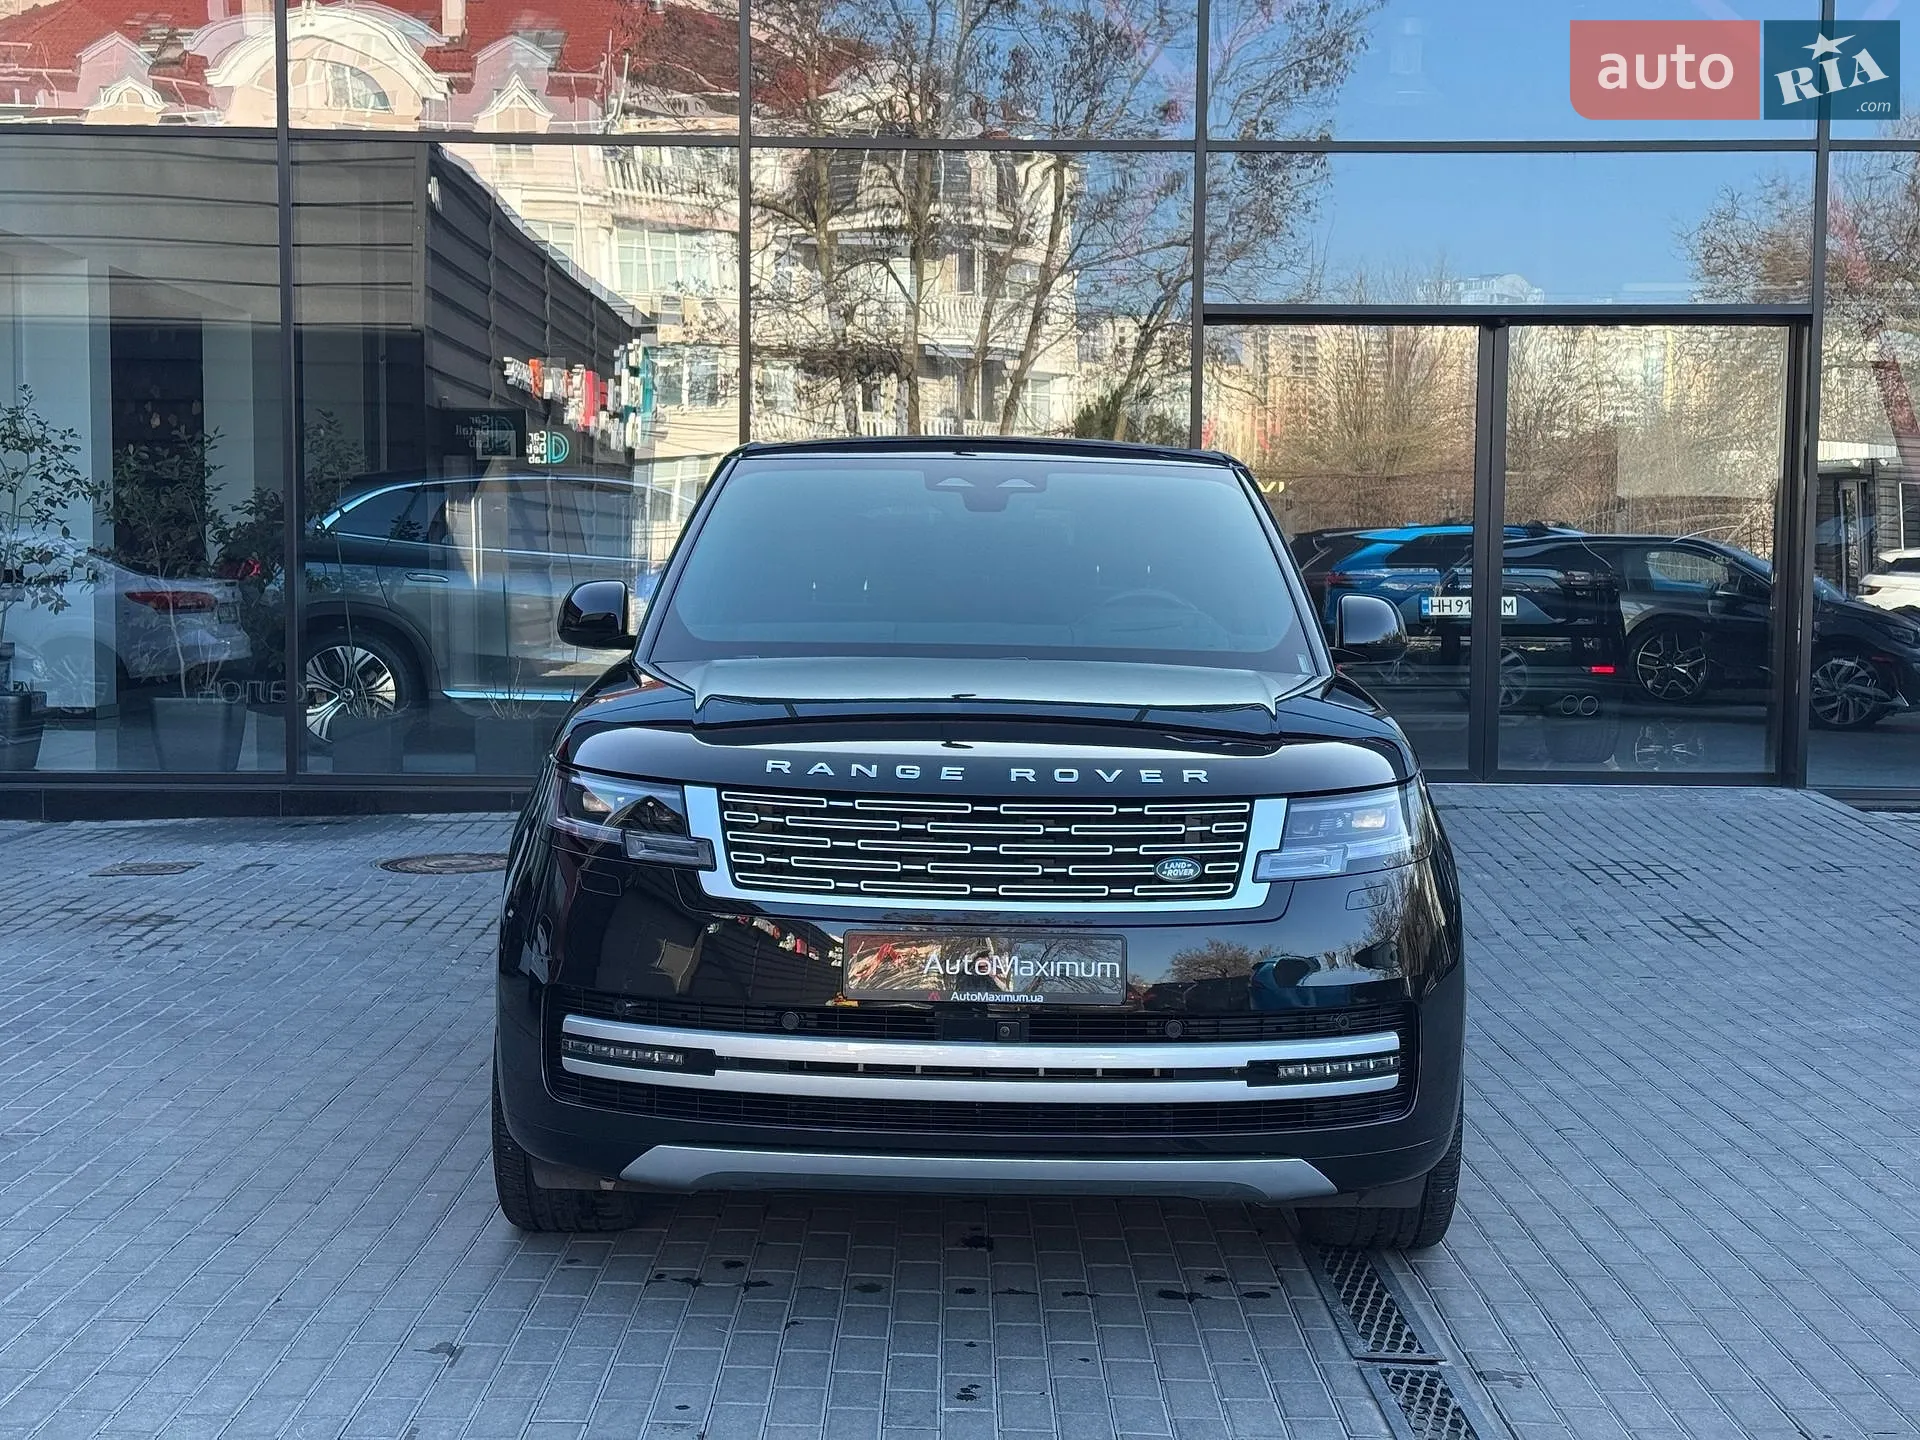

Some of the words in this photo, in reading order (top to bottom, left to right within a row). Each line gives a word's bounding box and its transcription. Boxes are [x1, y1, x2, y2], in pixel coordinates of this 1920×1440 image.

[765, 759, 965, 781] RANGE
[1010, 768, 1209, 783] ROVER
[1164, 861, 1187, 870] LAND
[1166, 868, 1194, 877] ROVER
[923, 954, 1120, 978] AutoMaximum
[950, 991, 1044, 1004] AutoMaximum.ua
